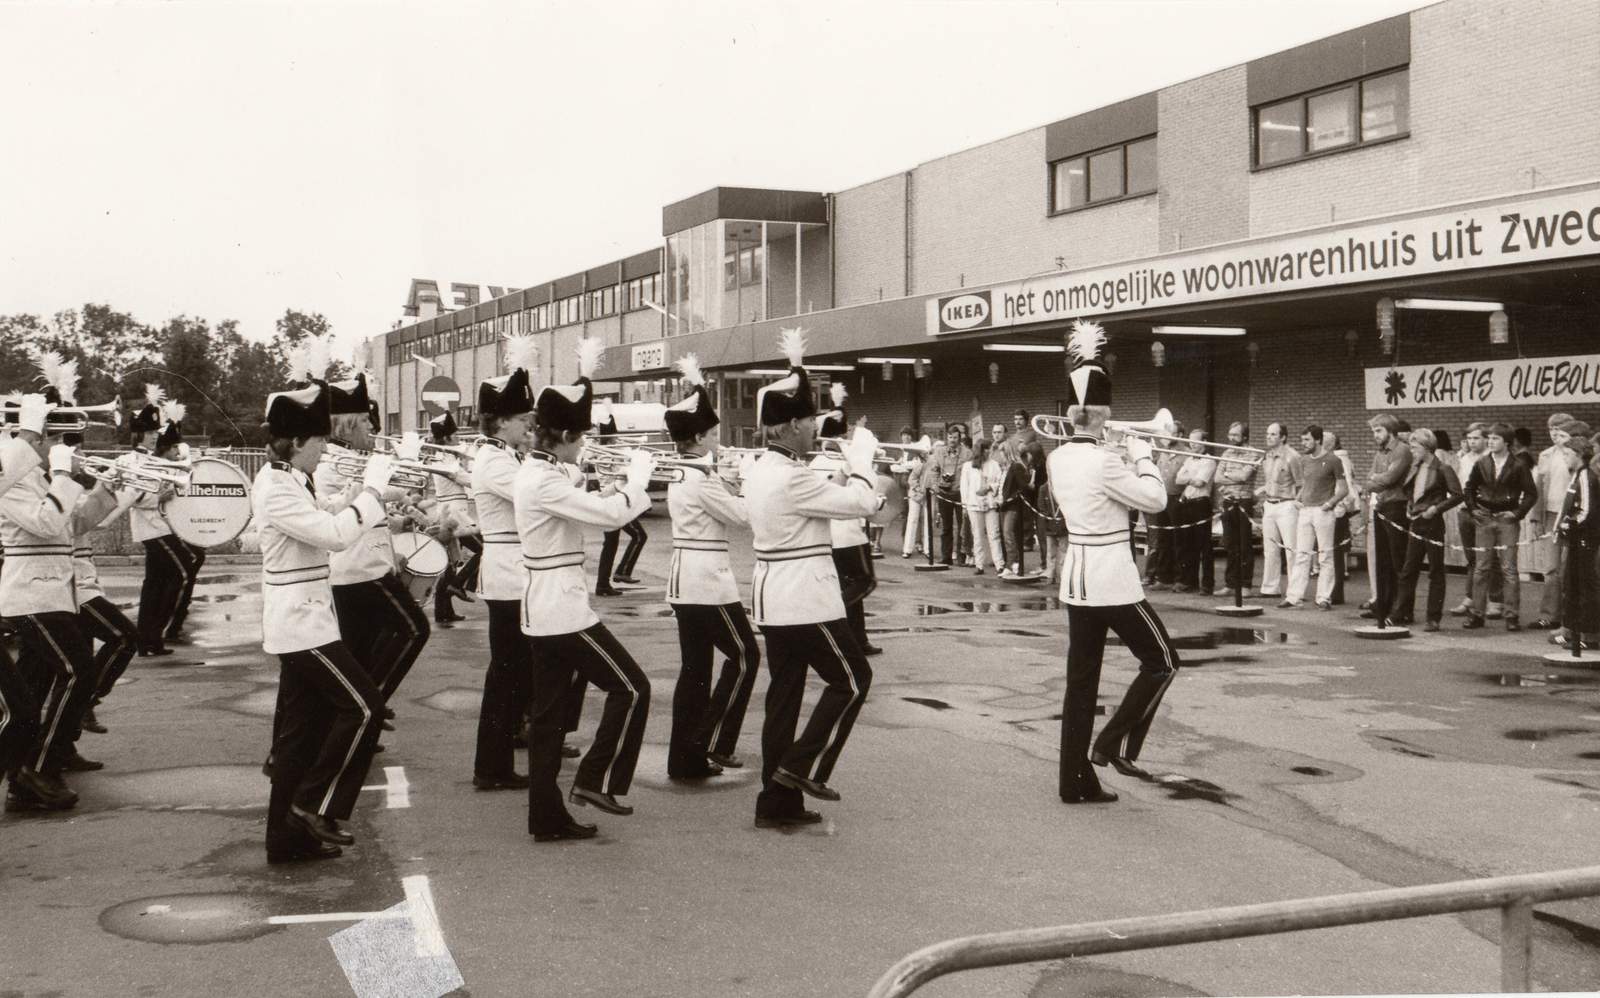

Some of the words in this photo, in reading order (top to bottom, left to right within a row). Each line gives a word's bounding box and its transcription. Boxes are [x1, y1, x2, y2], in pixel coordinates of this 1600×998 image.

[1004, 292, 1035, 319] het
[1043, 268, 1176, 313] onmogelijke
[1183, 230, 1417, 294] woonwarenhuis
[1432, 218, 1483, 262] uit
[947, 303, 984, 321] IKEA
[1414, 366, 1494, 403] GRATIS
